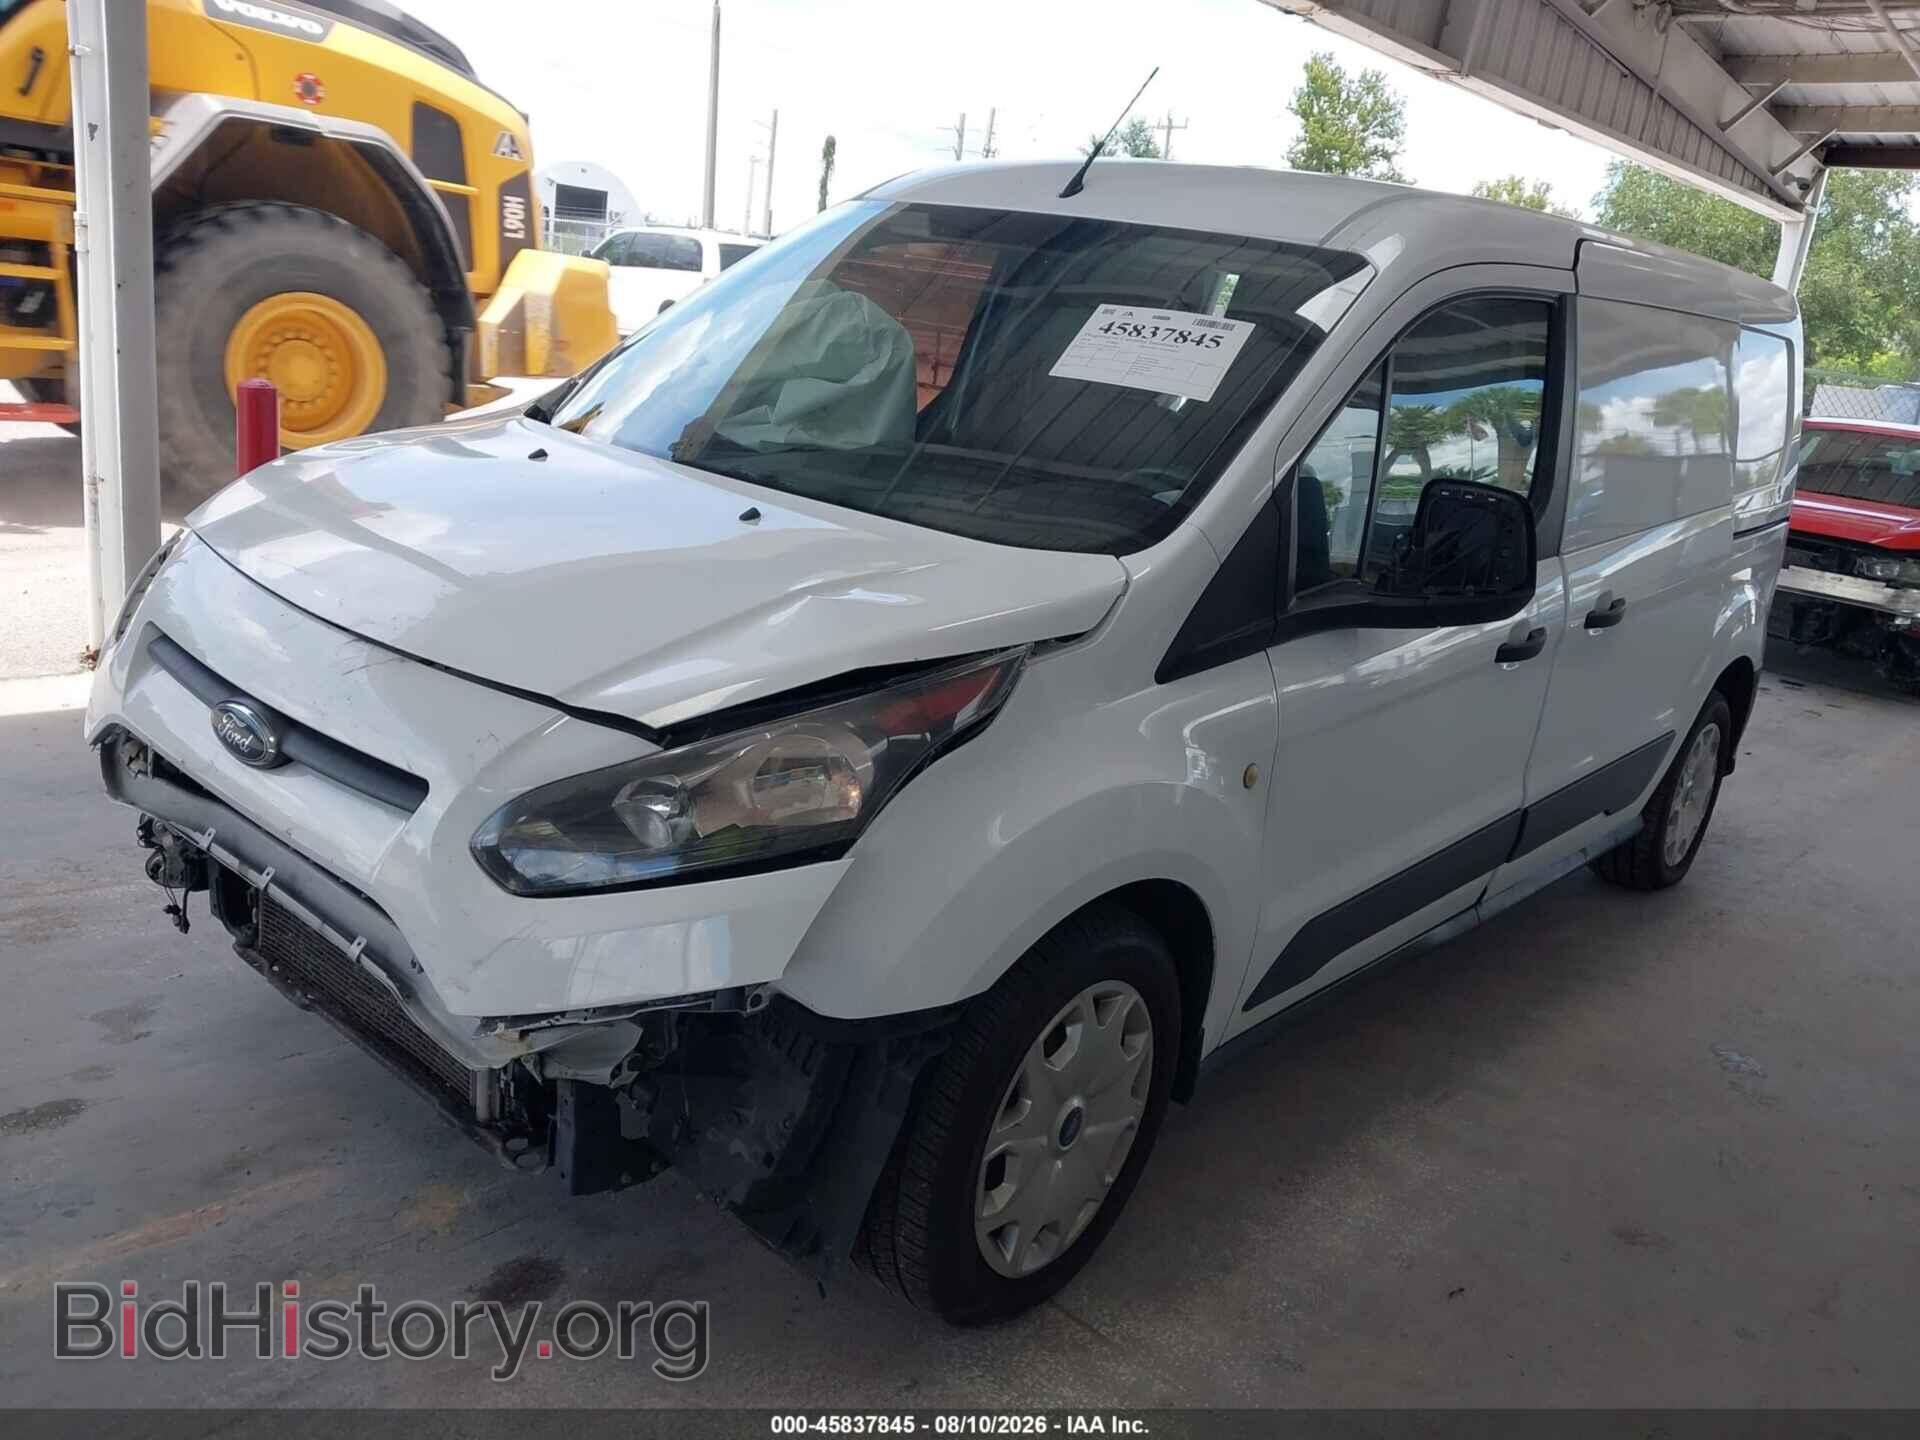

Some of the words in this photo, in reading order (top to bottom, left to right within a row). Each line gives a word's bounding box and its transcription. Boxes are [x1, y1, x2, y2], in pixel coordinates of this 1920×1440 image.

[503, 195, 526, 240] L90H
[1098, 320, 1225, 350] 45837845
[217, 711, 256, 753] Ford
